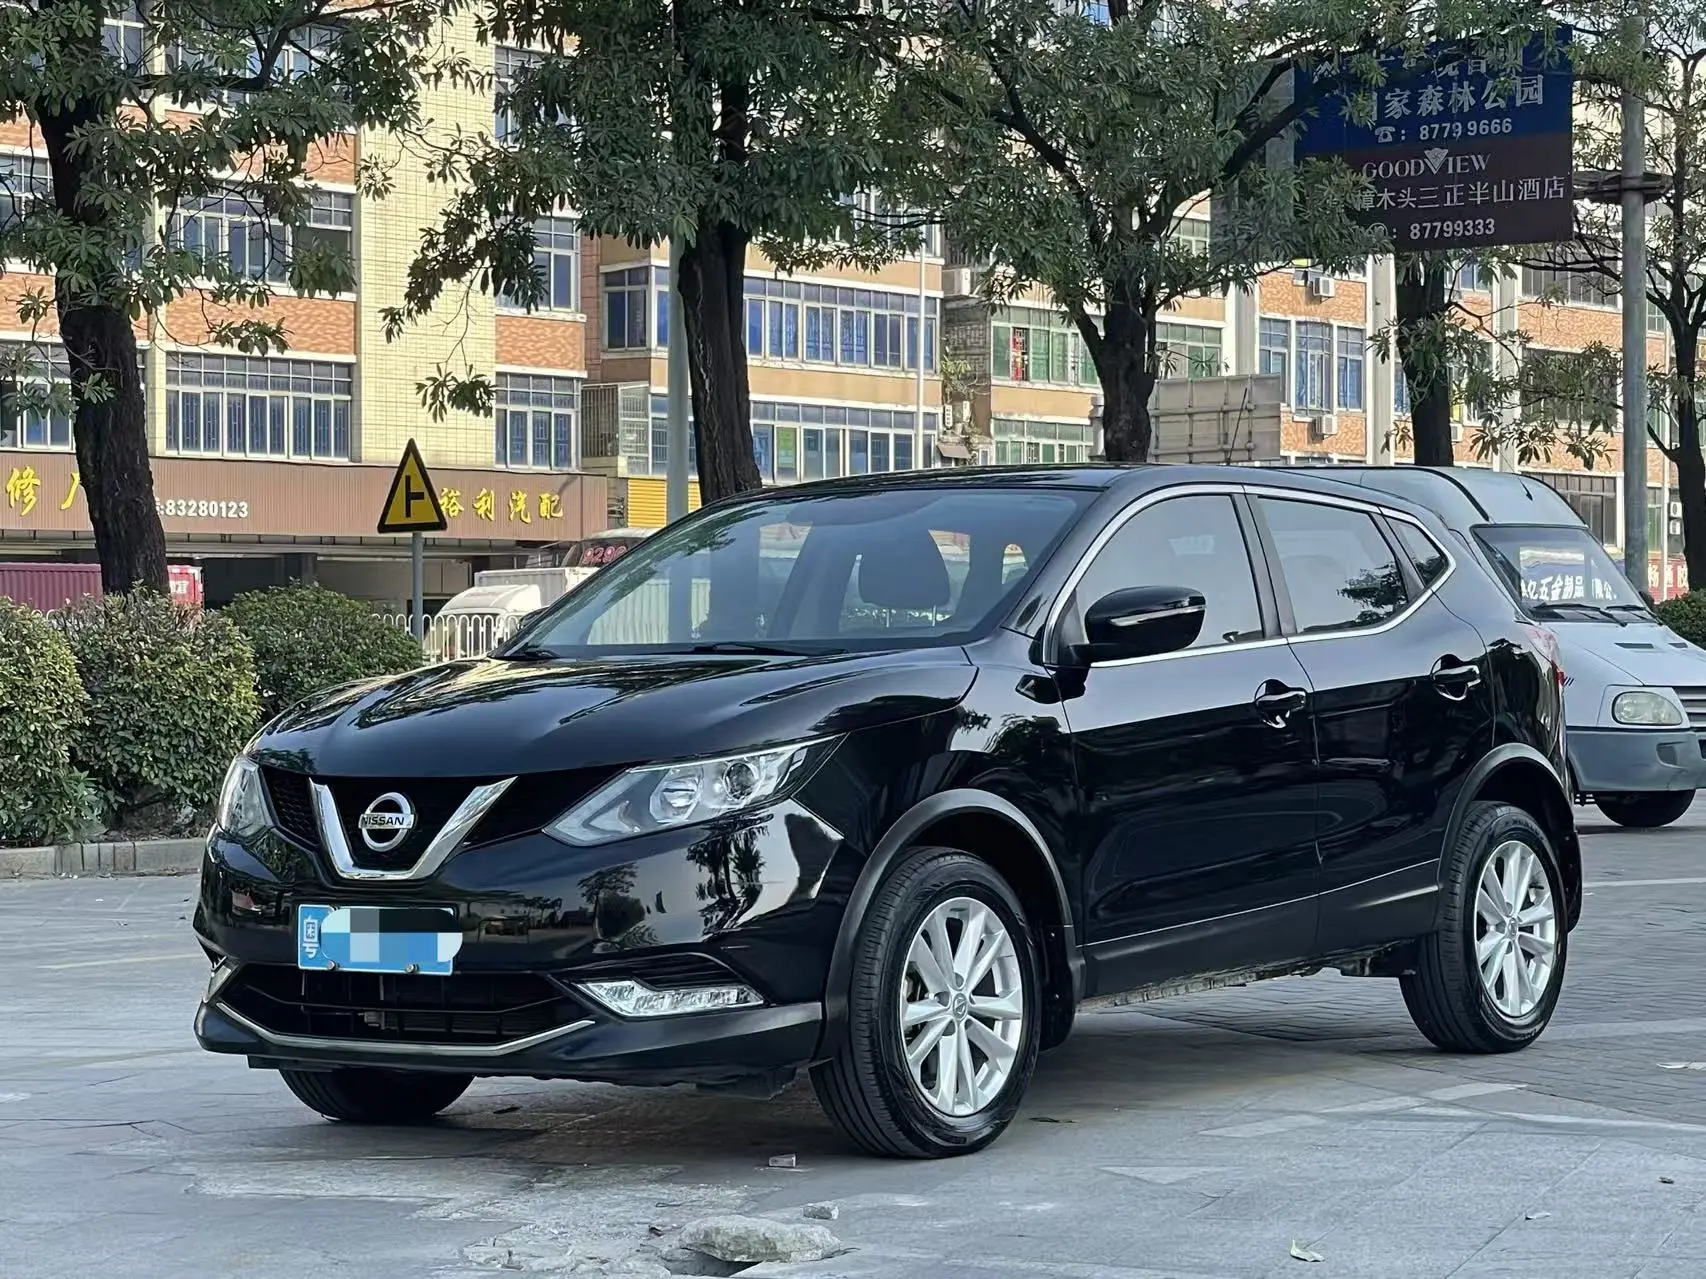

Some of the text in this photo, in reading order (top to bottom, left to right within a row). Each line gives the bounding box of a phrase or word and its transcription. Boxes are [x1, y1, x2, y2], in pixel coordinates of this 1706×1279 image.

[1373, 74, 1544, 121] 家森林公园
[440, 487, 564, 523] 裕利汽配
[361, 816, 404, 826] NISSAN
